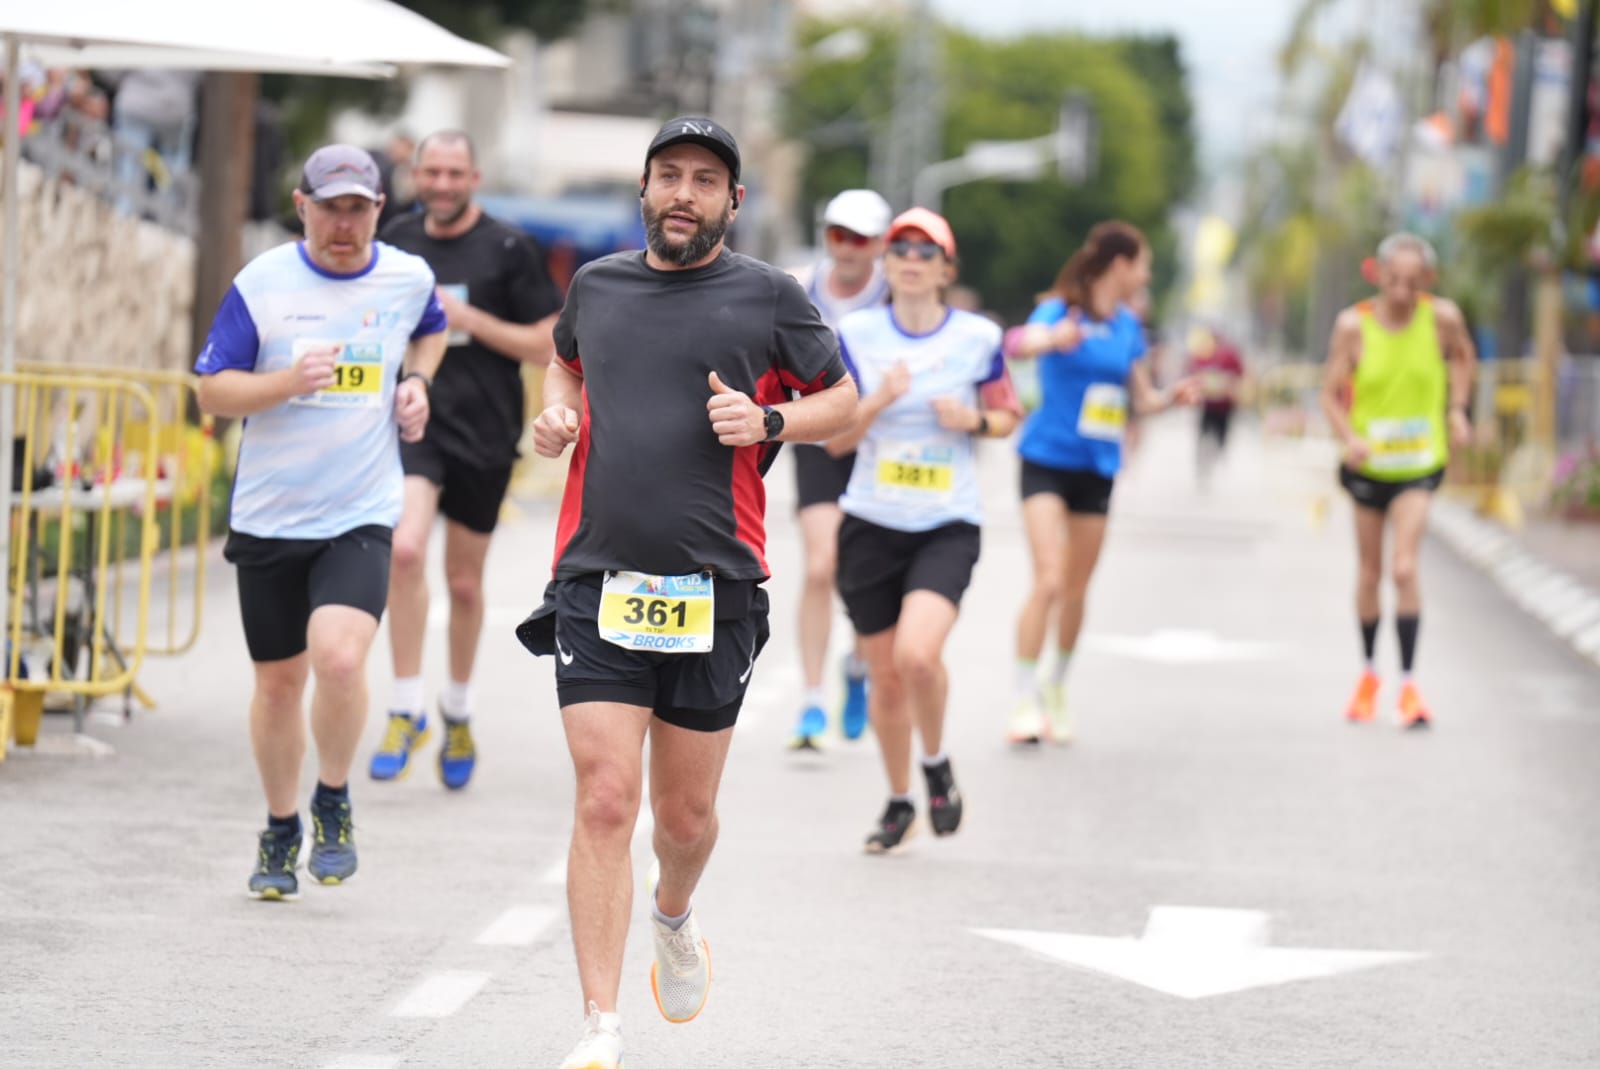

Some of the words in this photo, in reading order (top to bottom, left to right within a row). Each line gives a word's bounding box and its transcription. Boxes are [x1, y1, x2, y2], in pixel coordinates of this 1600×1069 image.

[334, 366, 364, 387] 19
[623, 597, 687, 628] 361
[633, 634, 696, 649] BROOKS
